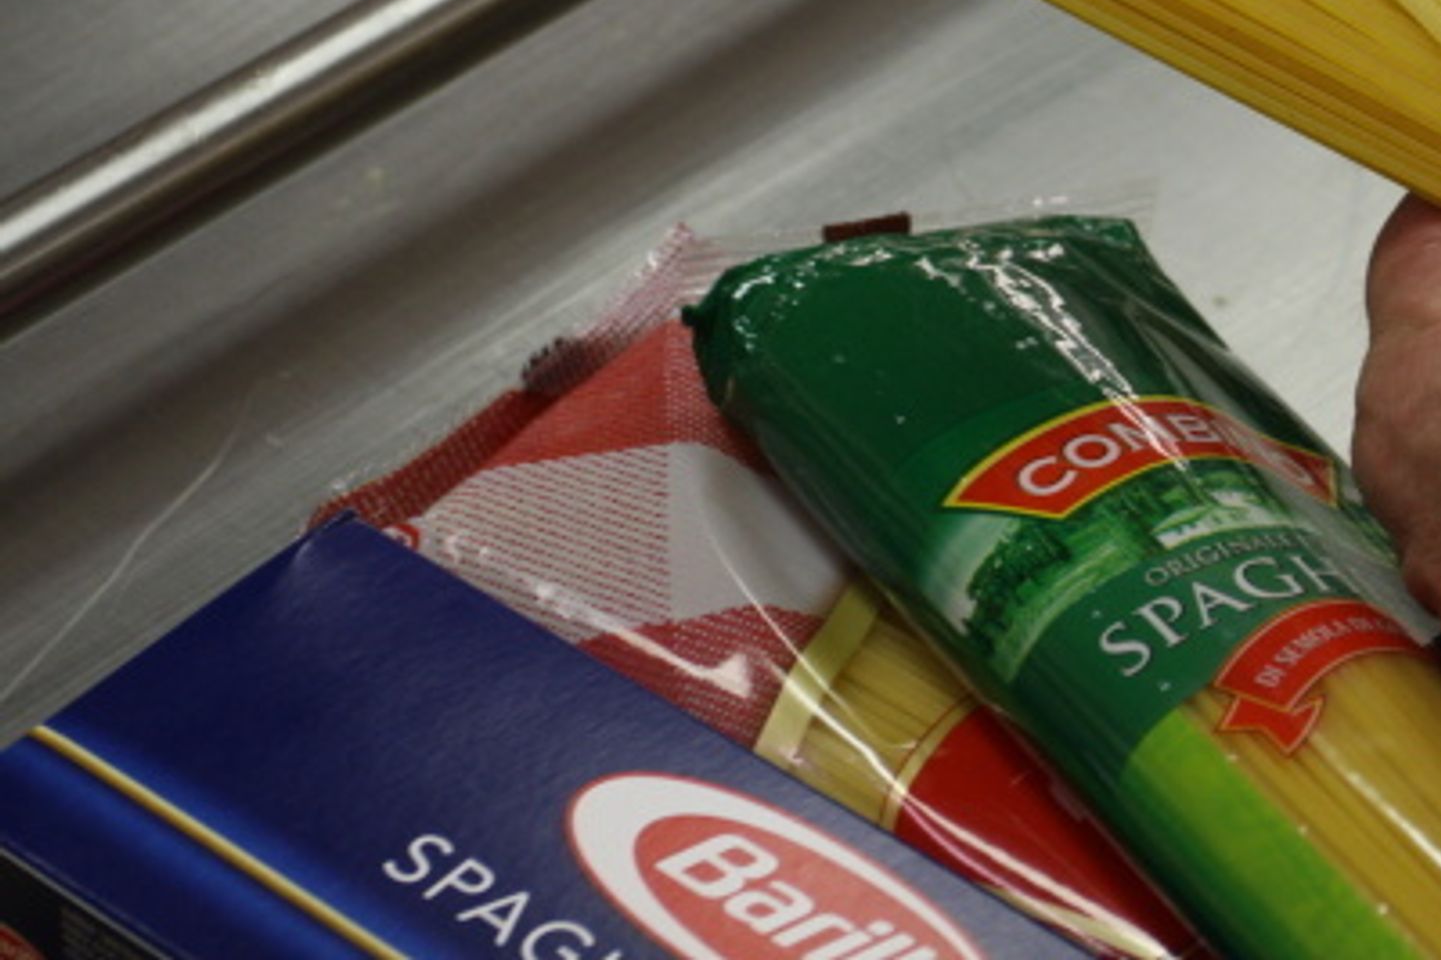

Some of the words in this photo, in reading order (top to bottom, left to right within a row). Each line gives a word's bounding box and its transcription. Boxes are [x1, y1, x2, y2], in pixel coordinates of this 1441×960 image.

[1016, 410, 1318, 496] COMBO
[382, 834, 623, 960] SPAG
[655, 834, 940, 960] Baril
